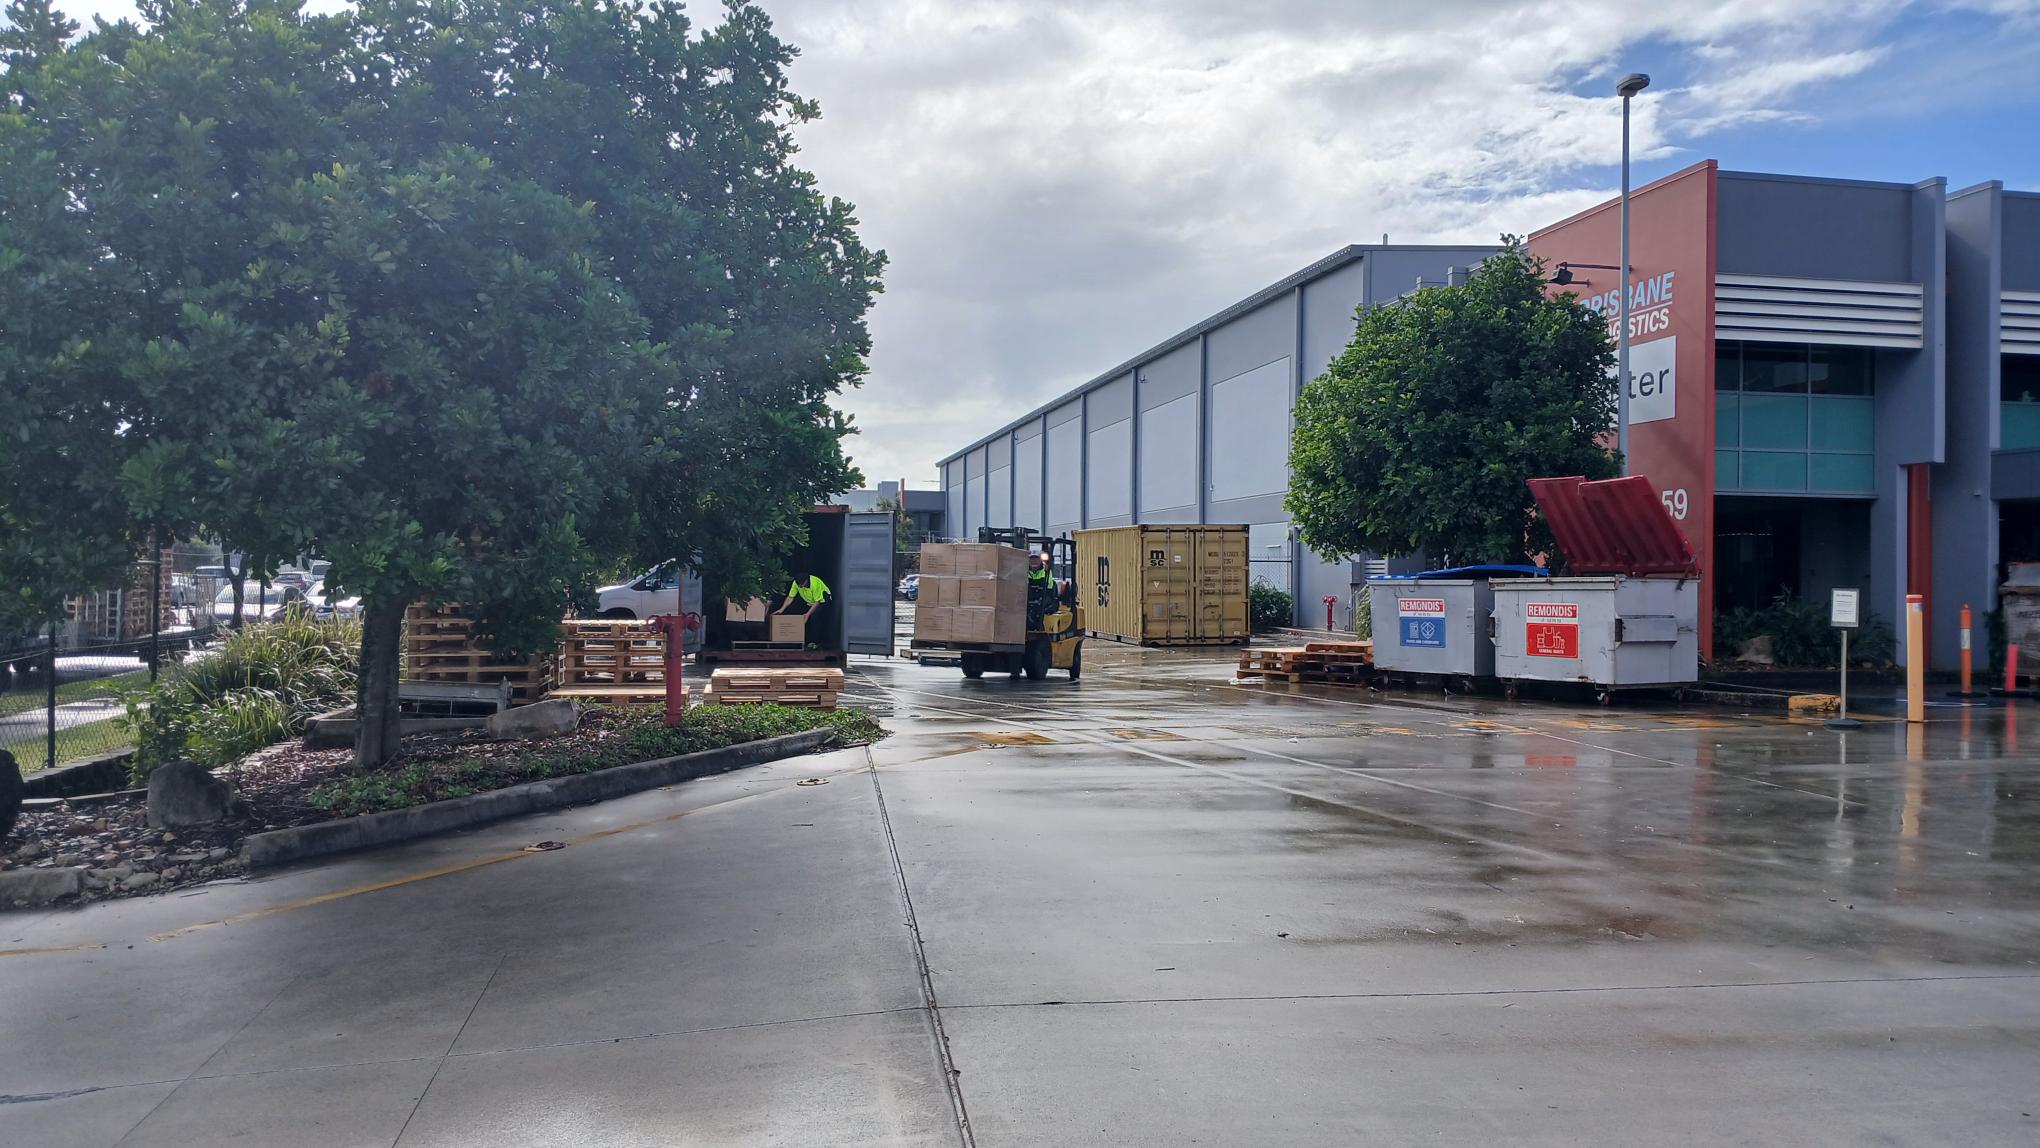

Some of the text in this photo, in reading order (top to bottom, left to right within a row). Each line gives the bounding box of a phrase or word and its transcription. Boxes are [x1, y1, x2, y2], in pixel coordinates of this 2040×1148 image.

[1604, 307, 1670, 343] OGSTICS
[1628, 368, 1670, 399] ter
[1662, 488, 1688, 520] 59
[1400, 601, 1440, 611] REMONDIS
[1528, 605, 1573, 617] REMONDIS
